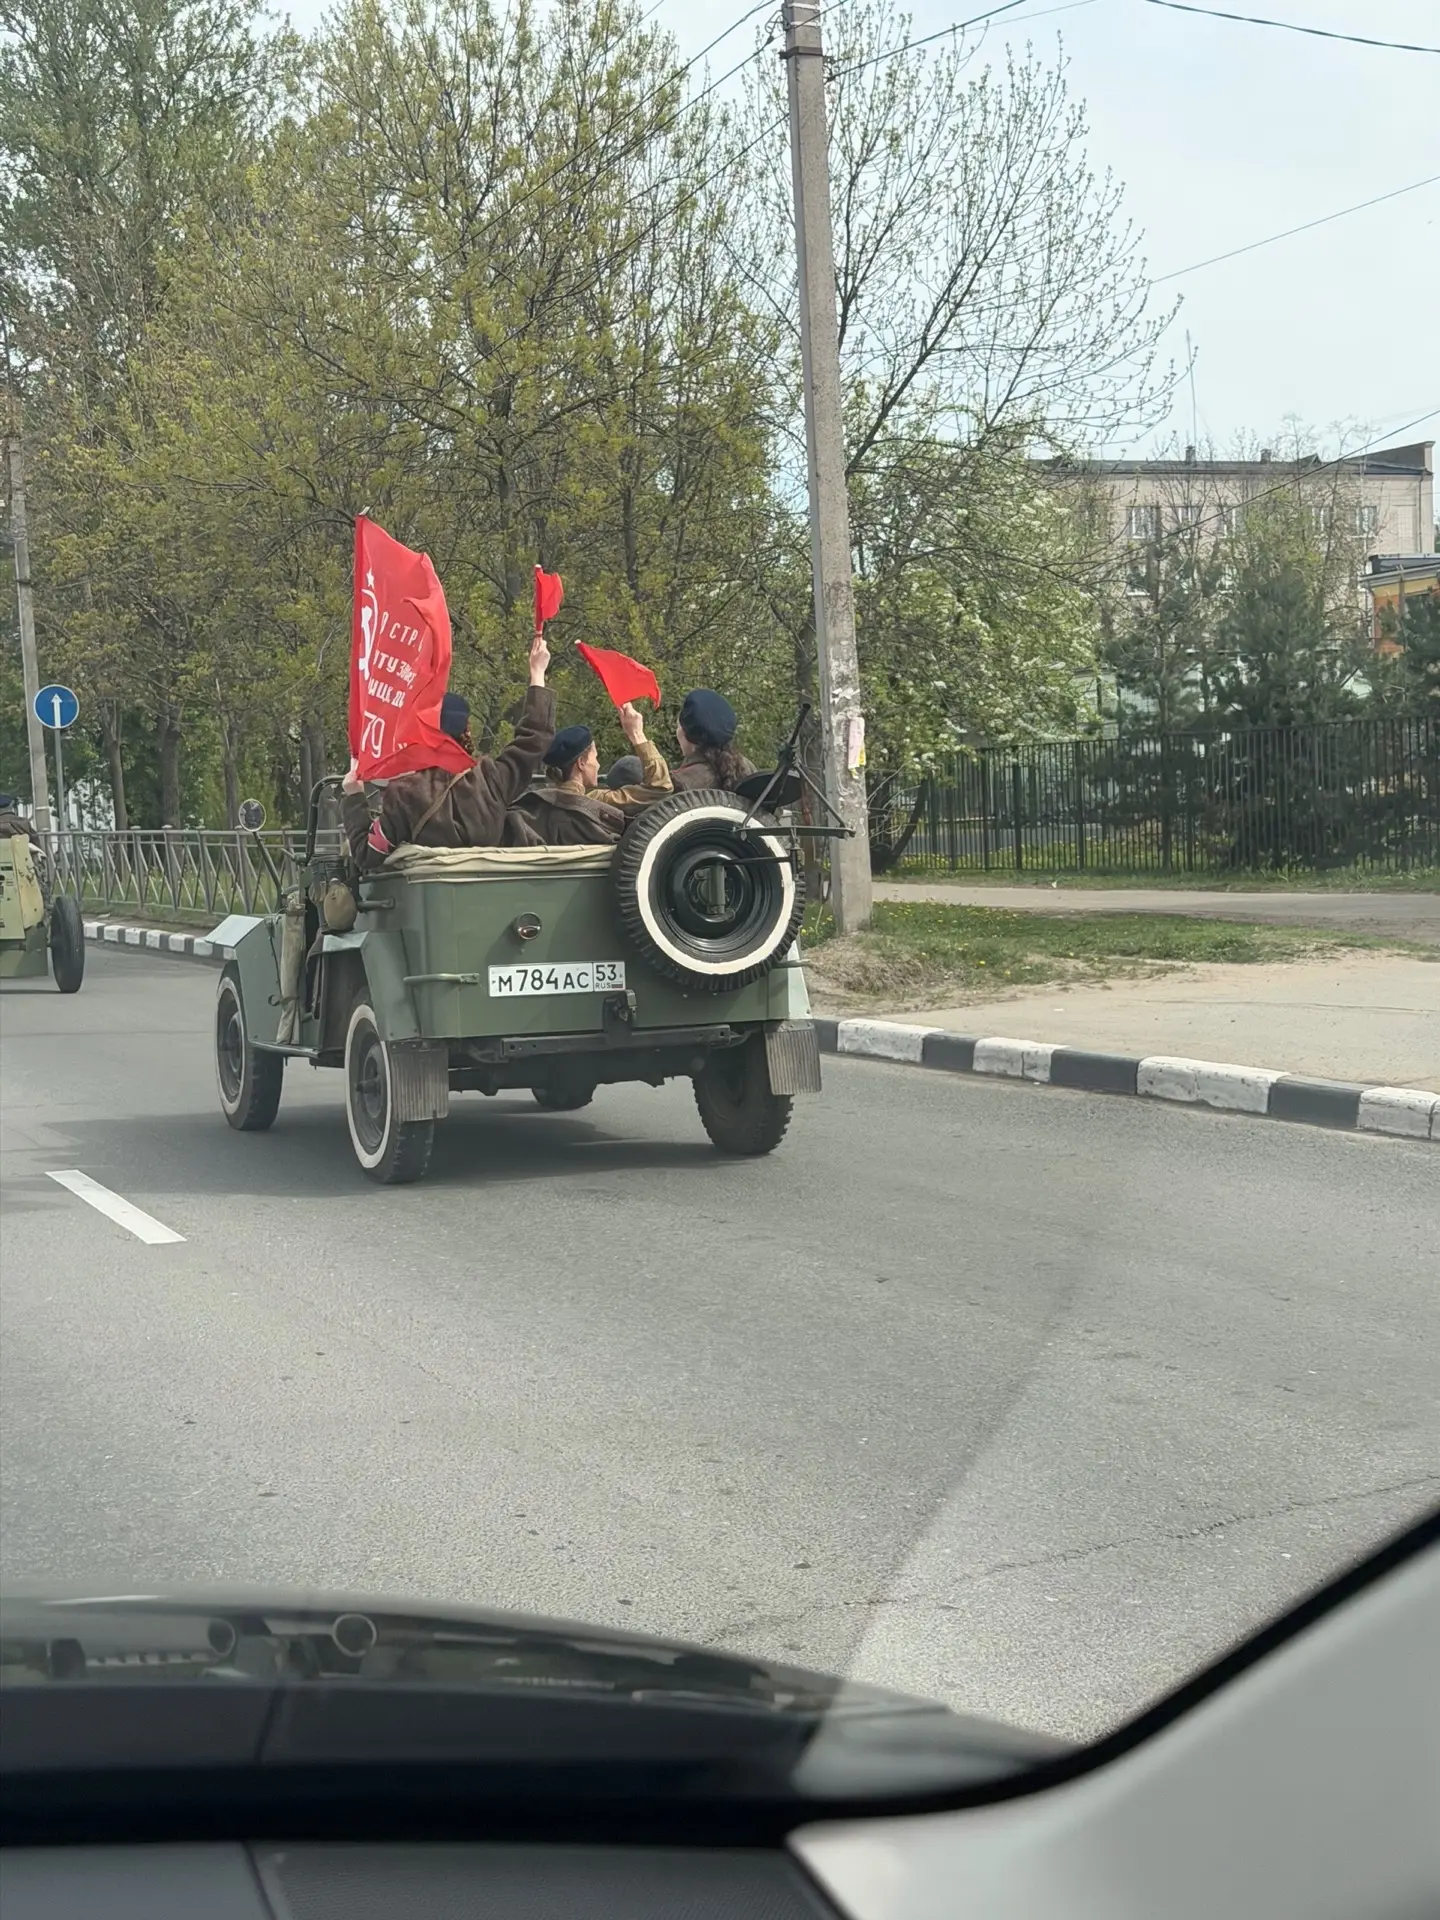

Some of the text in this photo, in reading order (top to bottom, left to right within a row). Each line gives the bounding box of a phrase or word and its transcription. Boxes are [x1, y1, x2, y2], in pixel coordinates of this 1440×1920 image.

[361, 710, 385, 759] 79
[498, 964, 617, 993] М784АС 53
